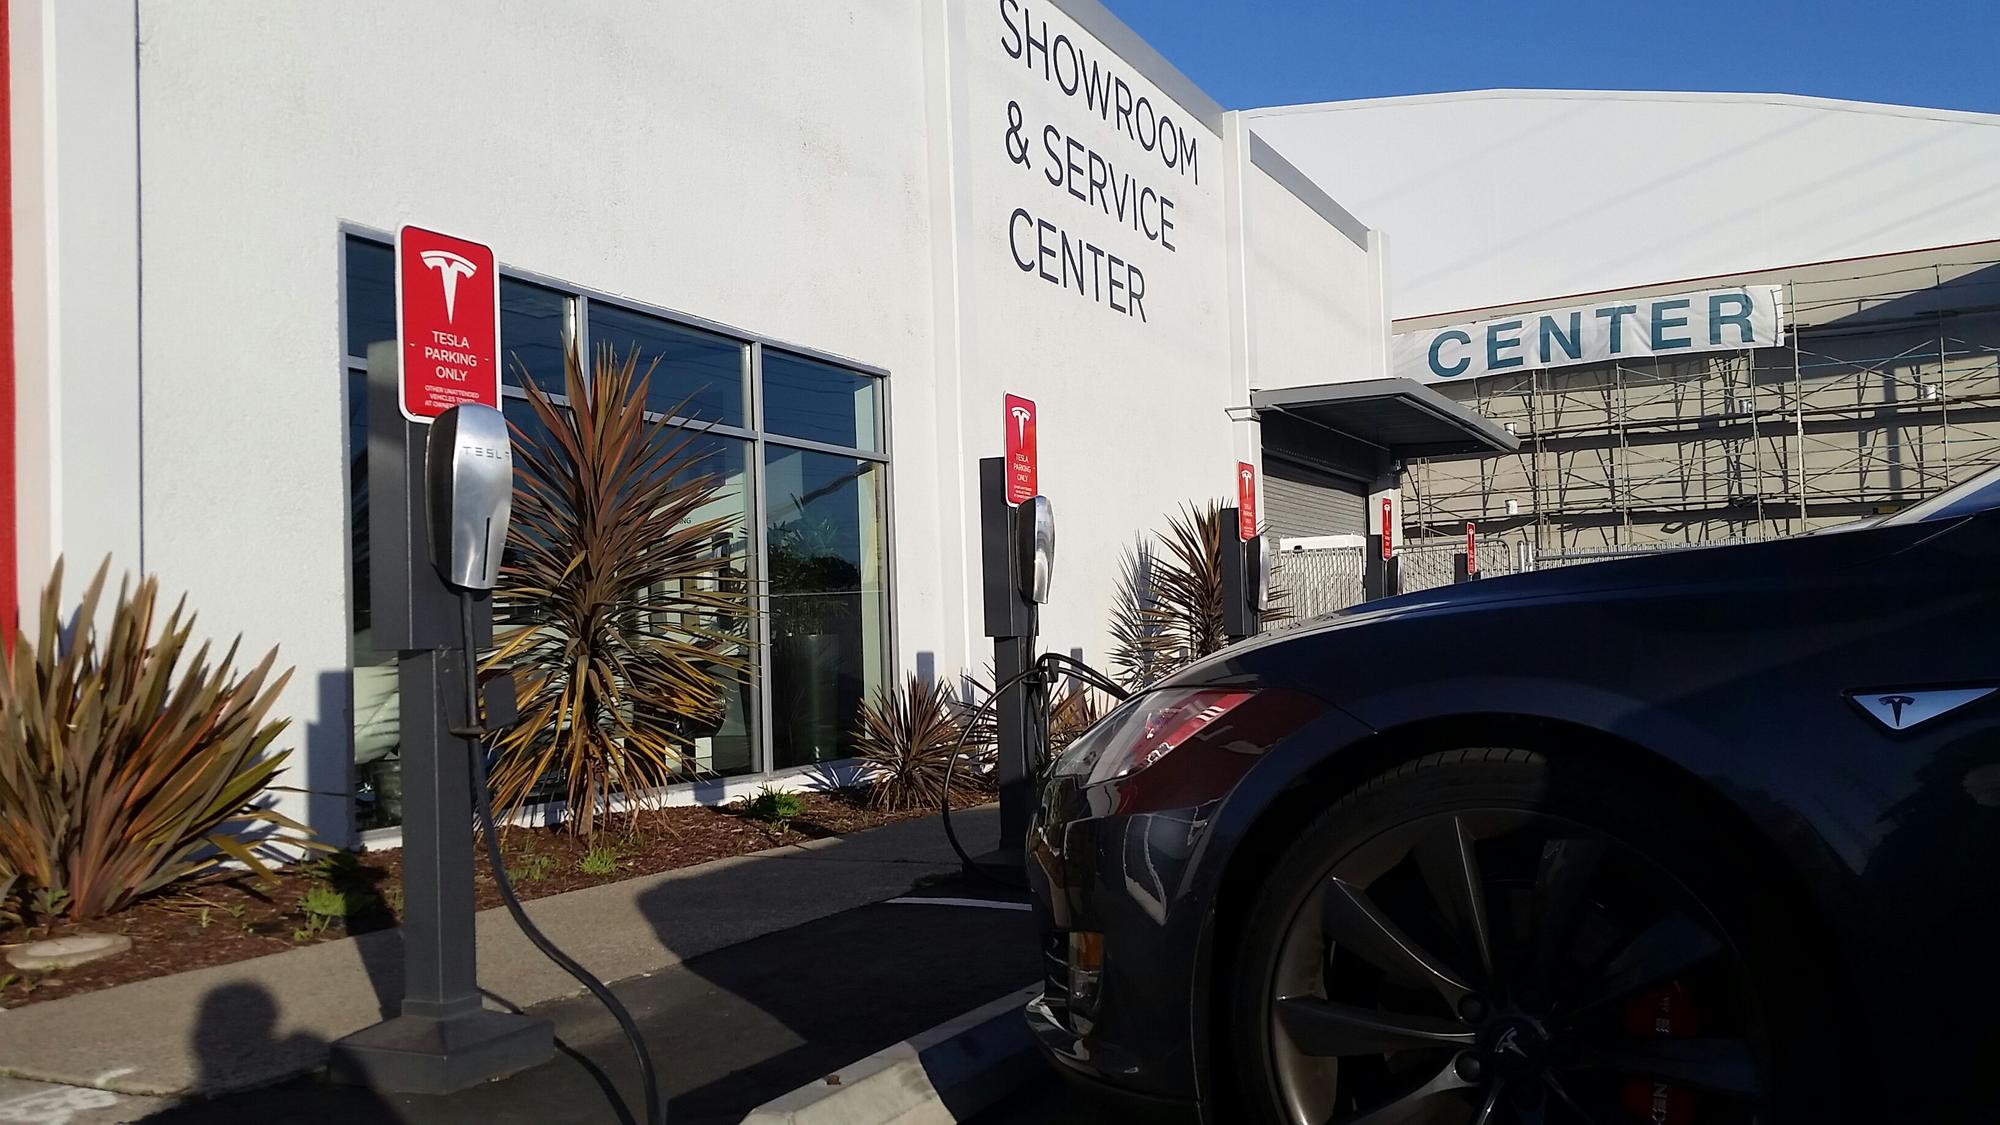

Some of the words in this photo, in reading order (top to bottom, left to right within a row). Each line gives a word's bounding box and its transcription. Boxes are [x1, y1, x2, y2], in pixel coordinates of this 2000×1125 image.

[999, 0, 1198, 186] SHOWROOM
[1005, 100, 1031, 170] &
[1043, 124, 1176, 253] SERVICE
[1009, 207, 1147, 323] CENTER
[424, 346, 477, 367] PARKING
[431, 330, 470, 349] TESLA
[435, 365, 468, 382] ONLY
[1427, 293, 1756, 378] CENTER
